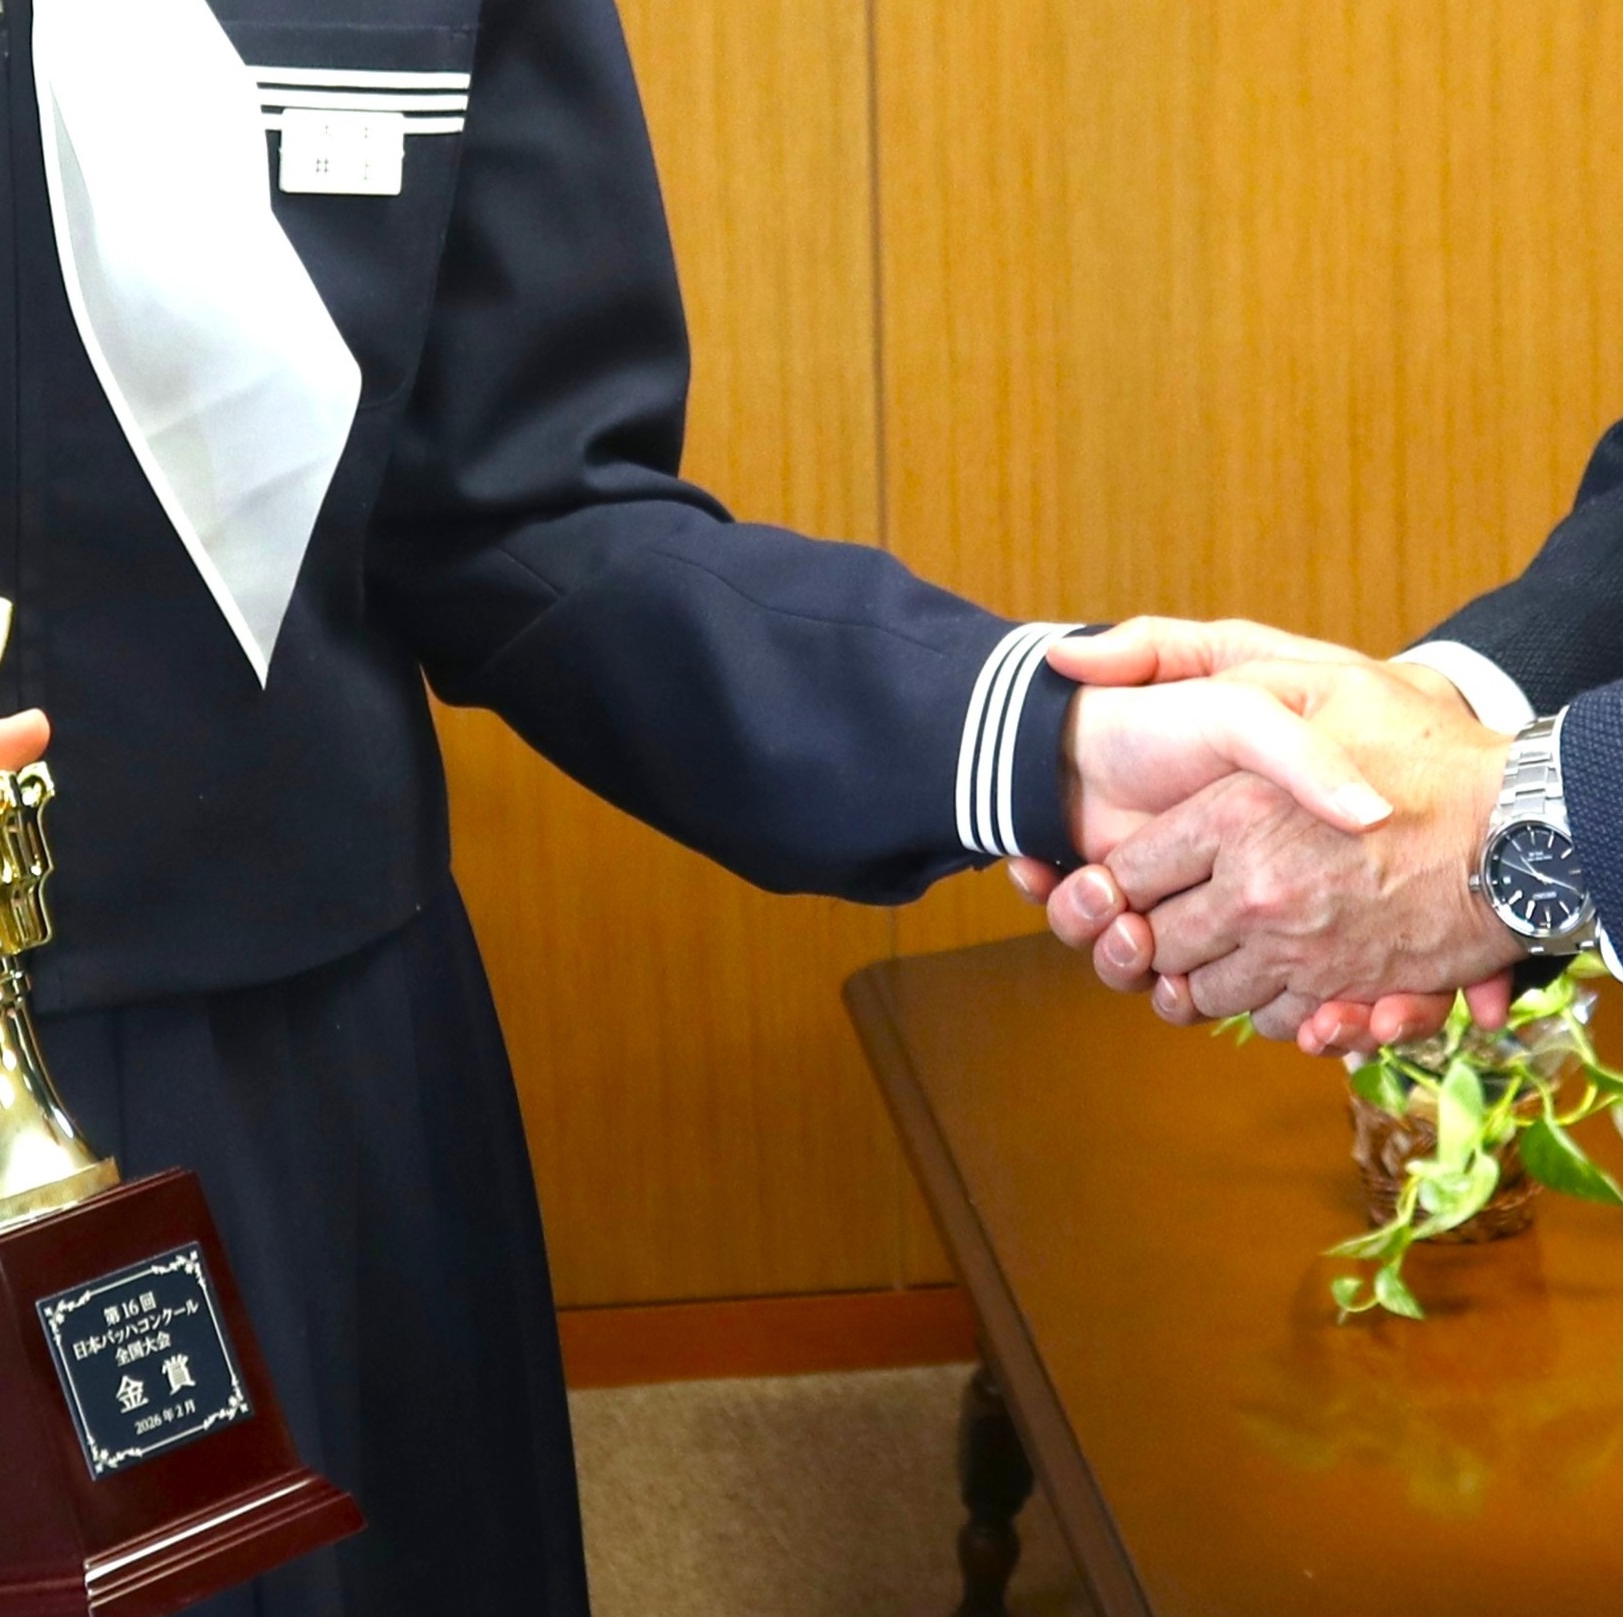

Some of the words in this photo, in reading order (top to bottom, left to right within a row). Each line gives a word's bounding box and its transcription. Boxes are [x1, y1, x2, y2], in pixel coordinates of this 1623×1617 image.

[103, 1291, 156, 1326] 第16回
[115, 1330, 172, 1367] 全国大会
[134, 1398, 196, 1435] 2026年2月
